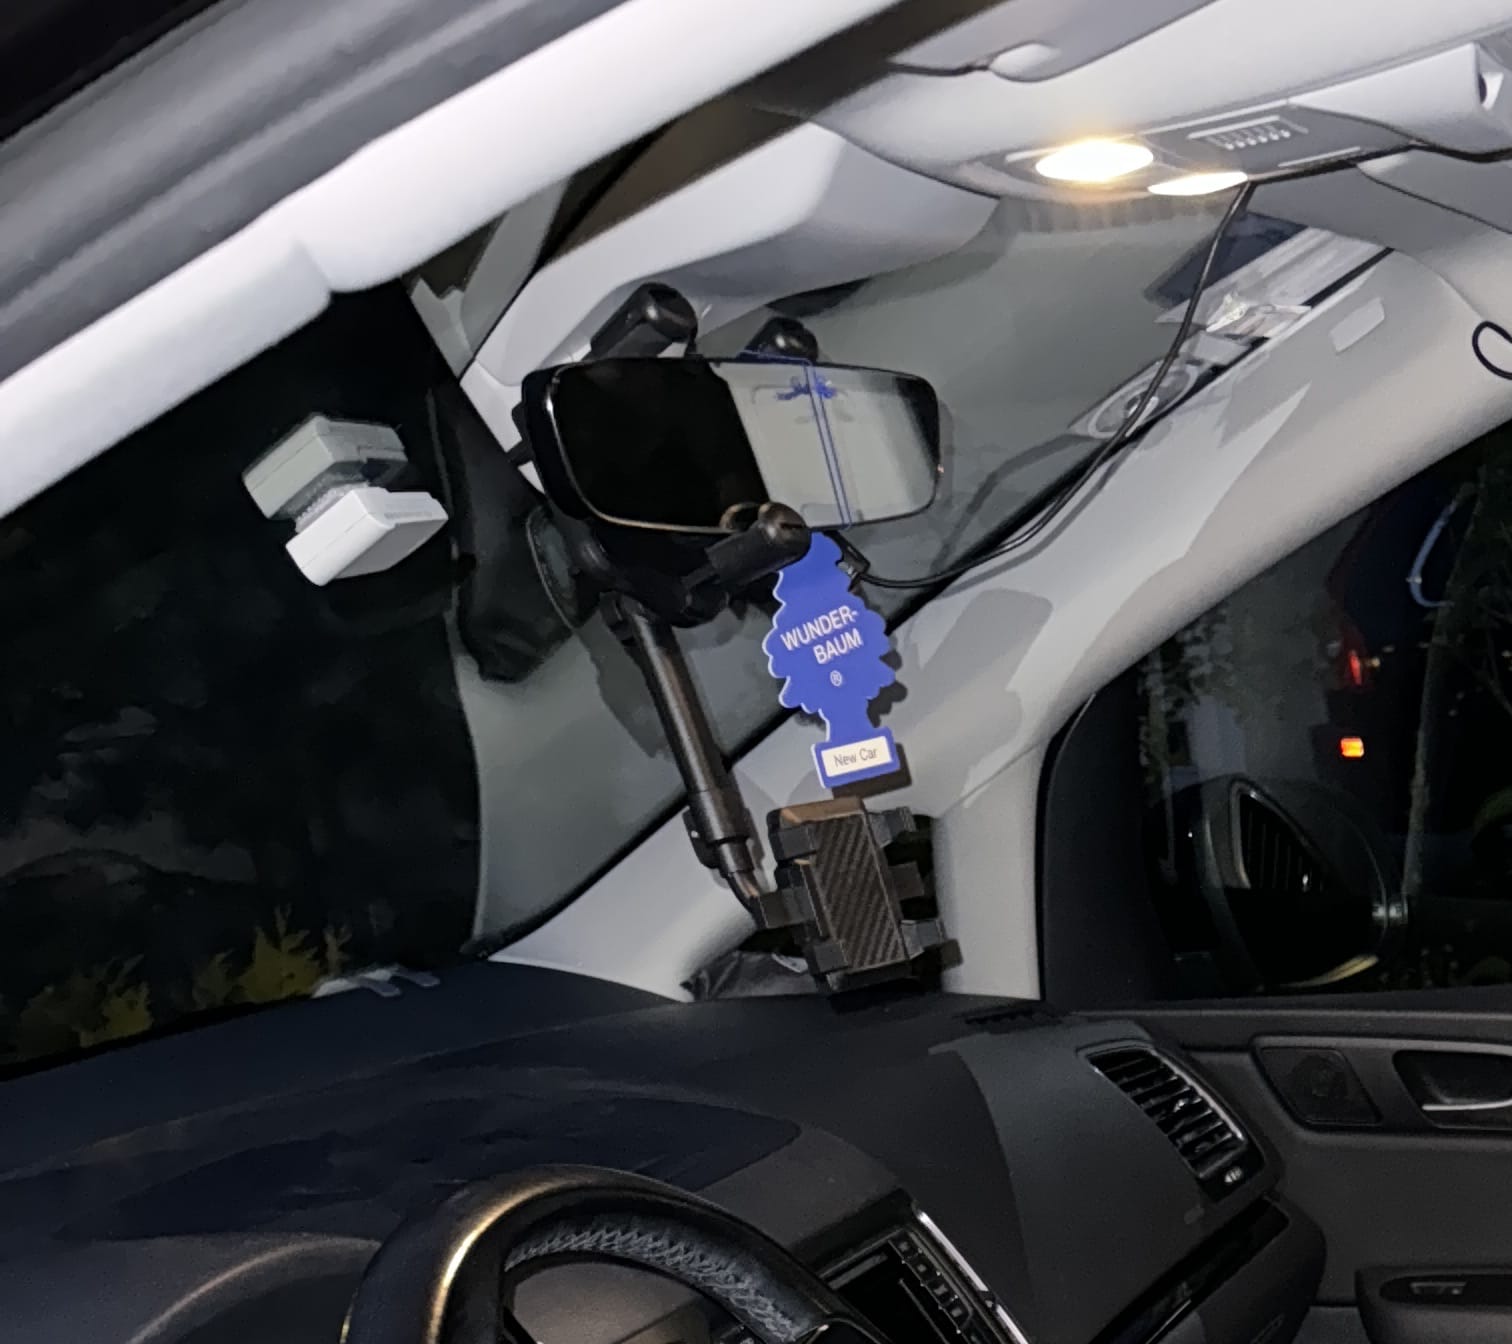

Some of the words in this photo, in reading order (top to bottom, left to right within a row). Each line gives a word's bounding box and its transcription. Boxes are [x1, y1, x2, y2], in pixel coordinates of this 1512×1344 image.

[780, 604, 859, 651] WUNDER-
[812, 628, 864, 665] BAUM
[834, 751, 857, 768] New
[859, 747, 878, 761] Car
